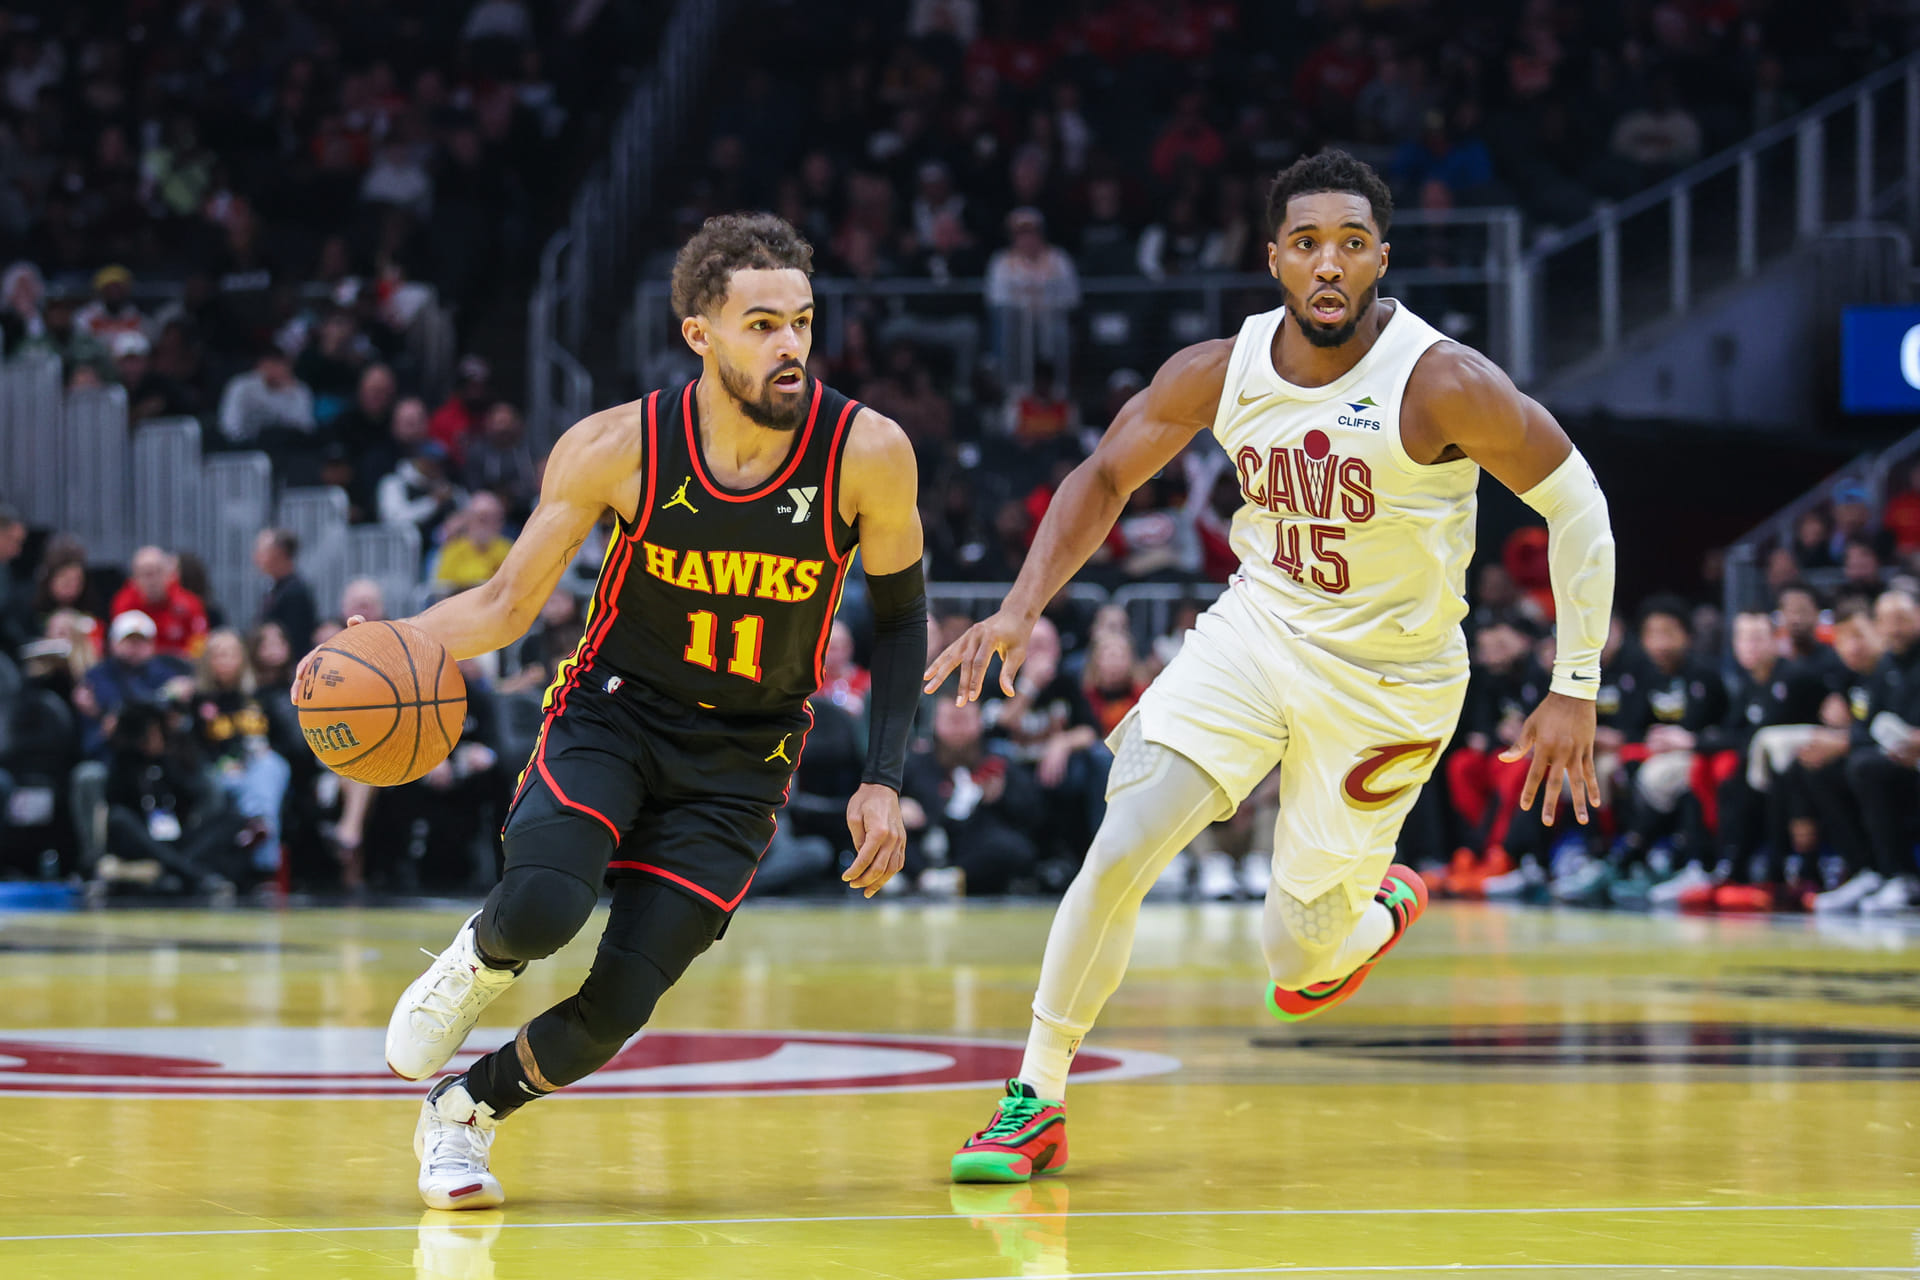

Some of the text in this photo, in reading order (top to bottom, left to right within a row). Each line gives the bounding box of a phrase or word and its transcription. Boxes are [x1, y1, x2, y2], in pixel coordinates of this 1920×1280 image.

[1338, 415, 1380, 431] CLIFFS
[777, 505, 792, 514] the
[1237, 446, 1375, 522] CAVS
[643, 540, 824, 603] HAWKS
[1272, 519, 1350, 594] 45
[683, 609, 764, 683] 11
